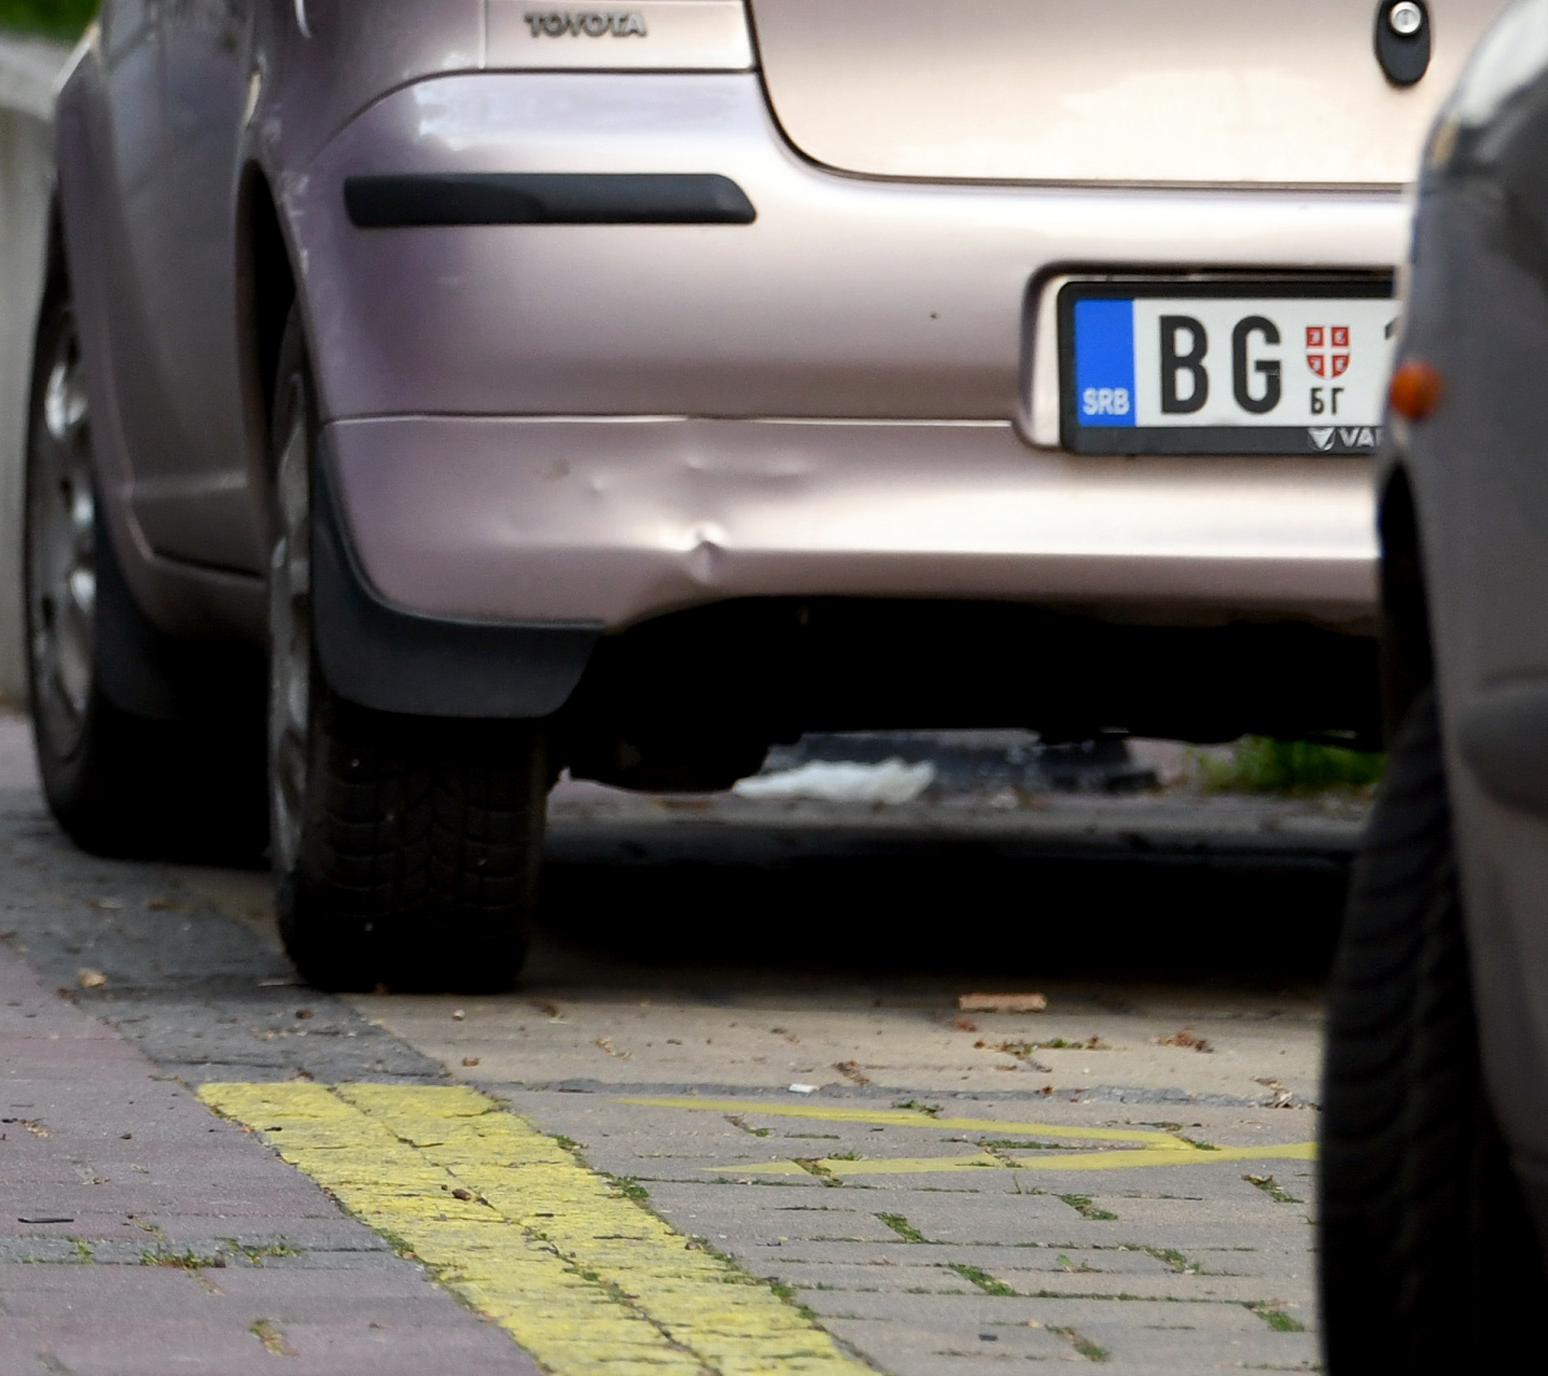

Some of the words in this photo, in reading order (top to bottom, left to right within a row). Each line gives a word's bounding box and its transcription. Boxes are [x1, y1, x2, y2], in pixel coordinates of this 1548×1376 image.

[523, 11, 648, 38] TOYOTA
[1159, 314, 1282, 415] BG
[1082, 387, 1131, 416] SRB
[1310, 386, 1345, 416] БГ
[1339, 427, 1381, 448] VA
